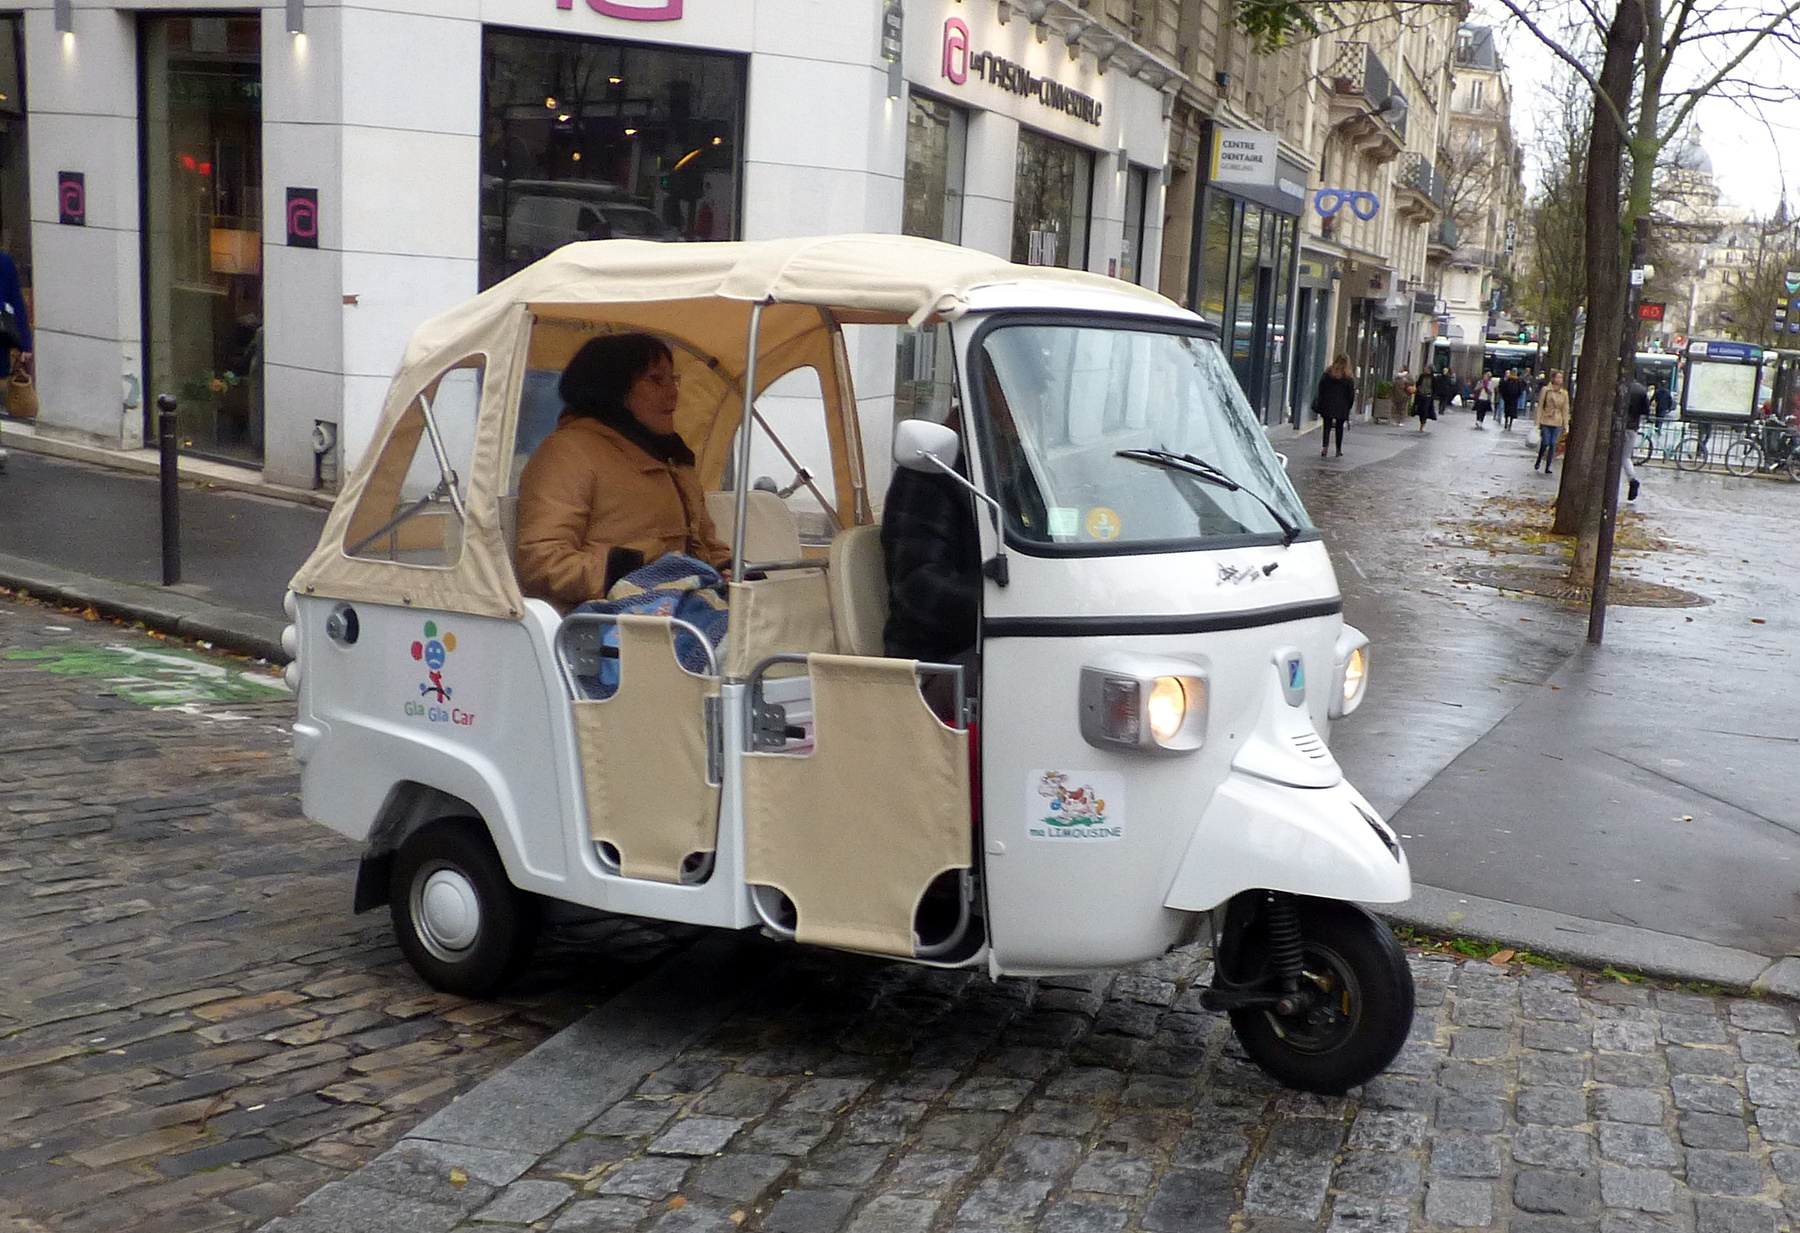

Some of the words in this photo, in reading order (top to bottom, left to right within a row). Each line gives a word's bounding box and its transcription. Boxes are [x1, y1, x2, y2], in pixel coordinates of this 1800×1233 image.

[1222, 140, 1256, 150] CENTRE
[1221, 152, 1264, 163] DENTAIRE
[404, 701, 425, 716] Gla
[428, 706, 449, 722] Gla
[452, 708, 475, 725] Car
[1048, 826, 1121, 838] LIMOUSINE
